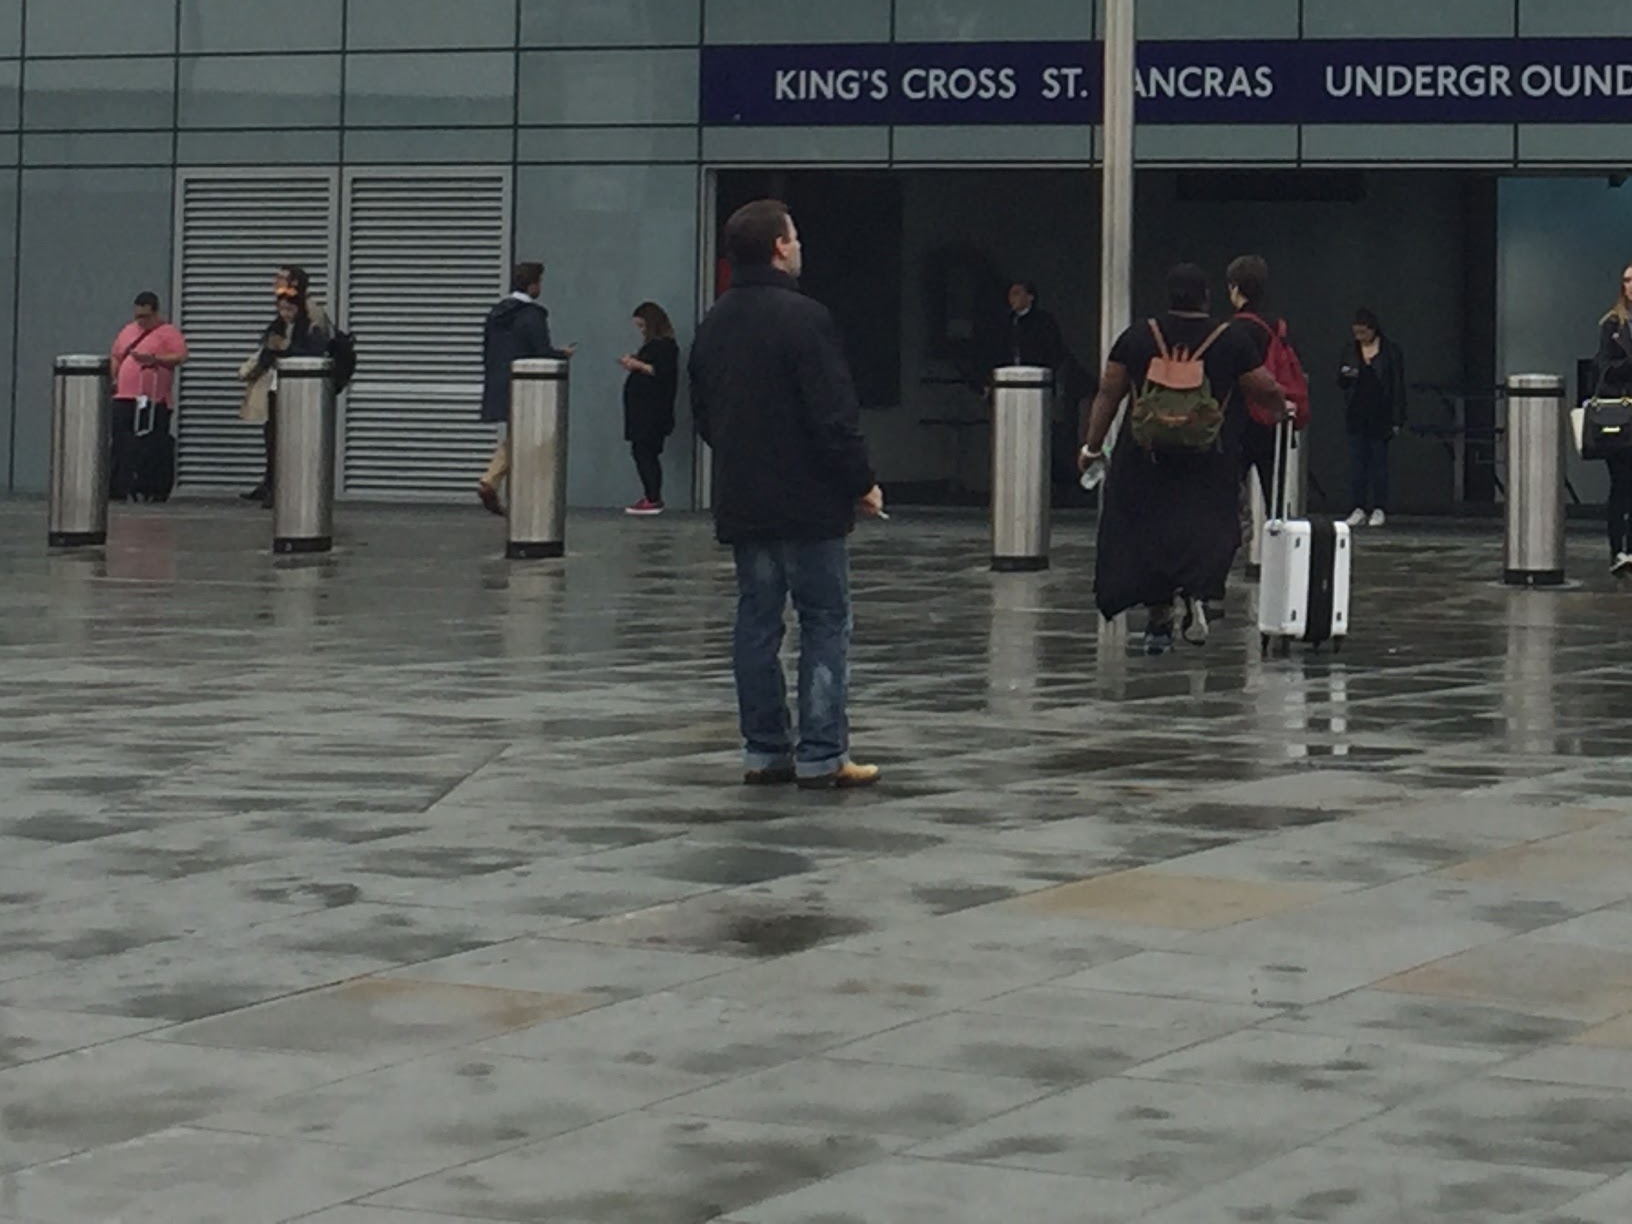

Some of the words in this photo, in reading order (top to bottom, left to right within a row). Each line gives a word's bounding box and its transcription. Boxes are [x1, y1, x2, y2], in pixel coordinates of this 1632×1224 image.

[776, 69, 887, 99] KING'S
[902, 68, 1015, 98] CROSS
[1042, 68, 1088, 97] ST.
[1134, 66, 1272, 96] ANCRAS
